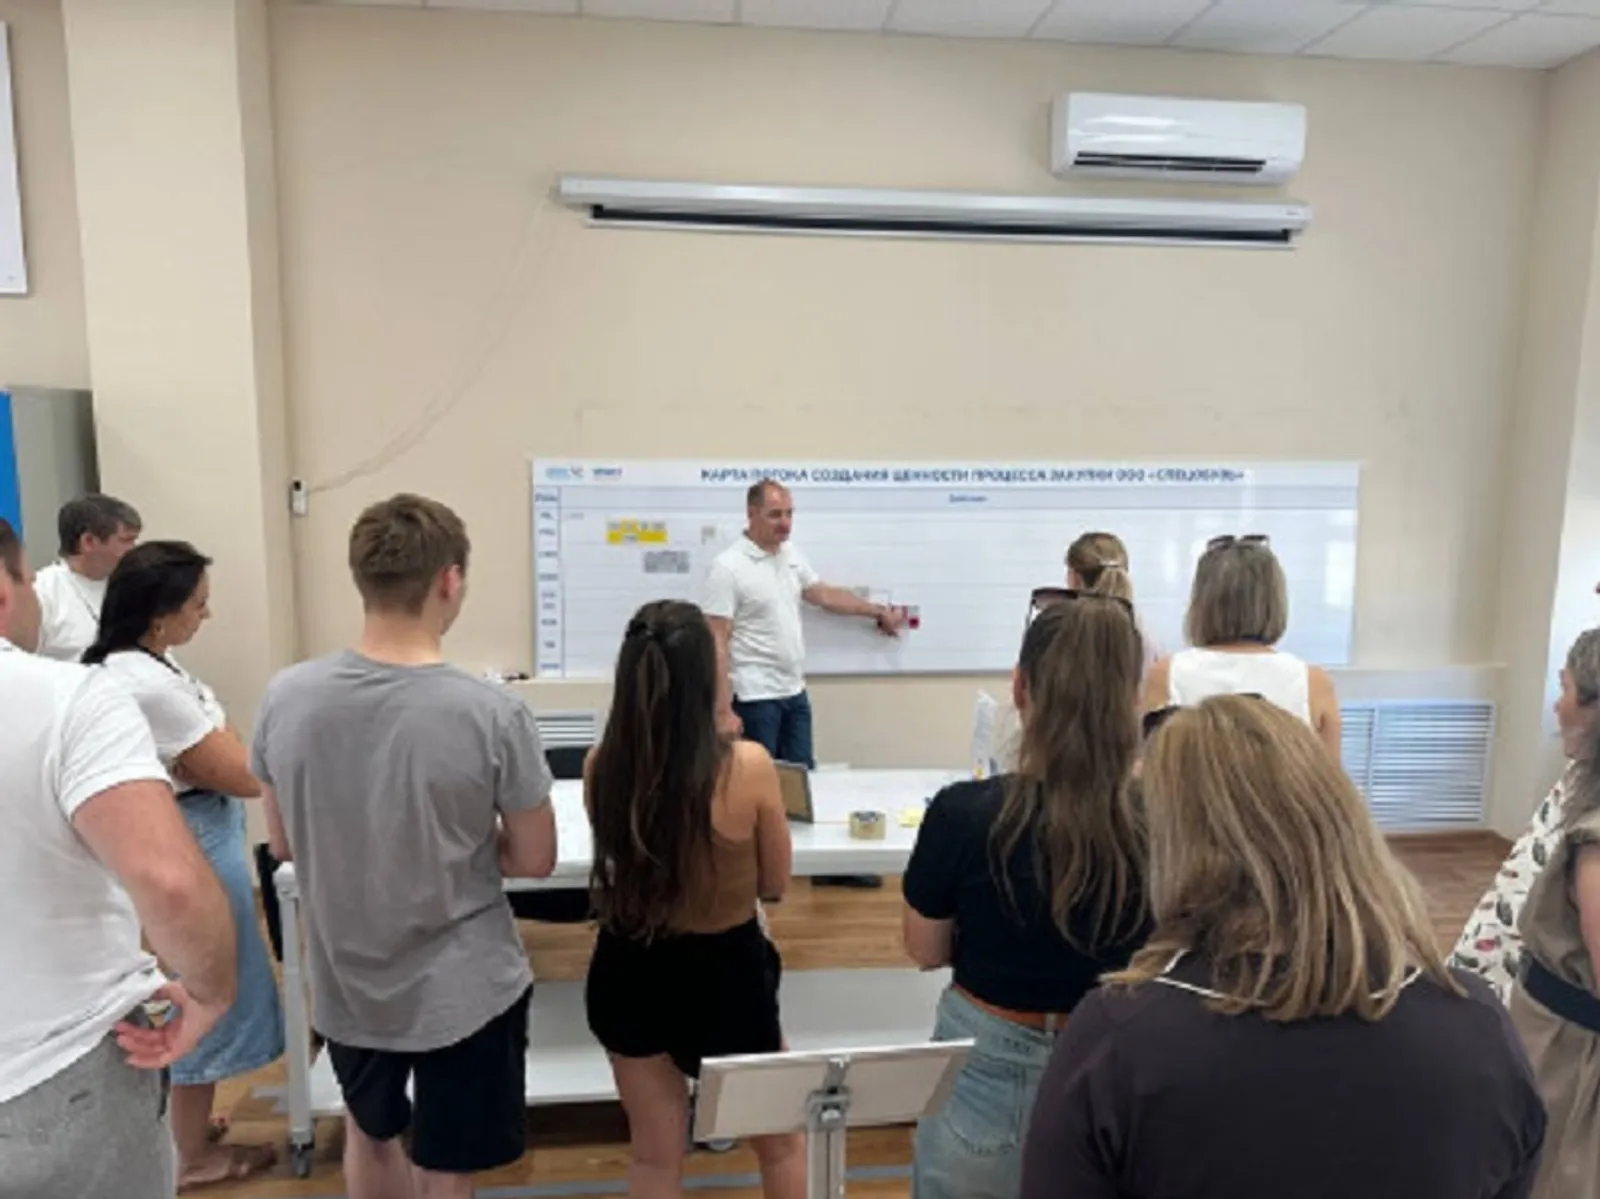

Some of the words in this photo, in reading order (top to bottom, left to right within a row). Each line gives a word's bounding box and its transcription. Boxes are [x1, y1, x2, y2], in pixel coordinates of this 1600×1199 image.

[701, 468, 749, 482] КАРТА
[811, 468, 889, 484] СОЗДАНИЯ
[893, 468, 969, 483] ЦЕННОСТИ
[971, 468, 1046, 483] ПРОЦЕССА
[1115, 468, 1145, 482] ООО
